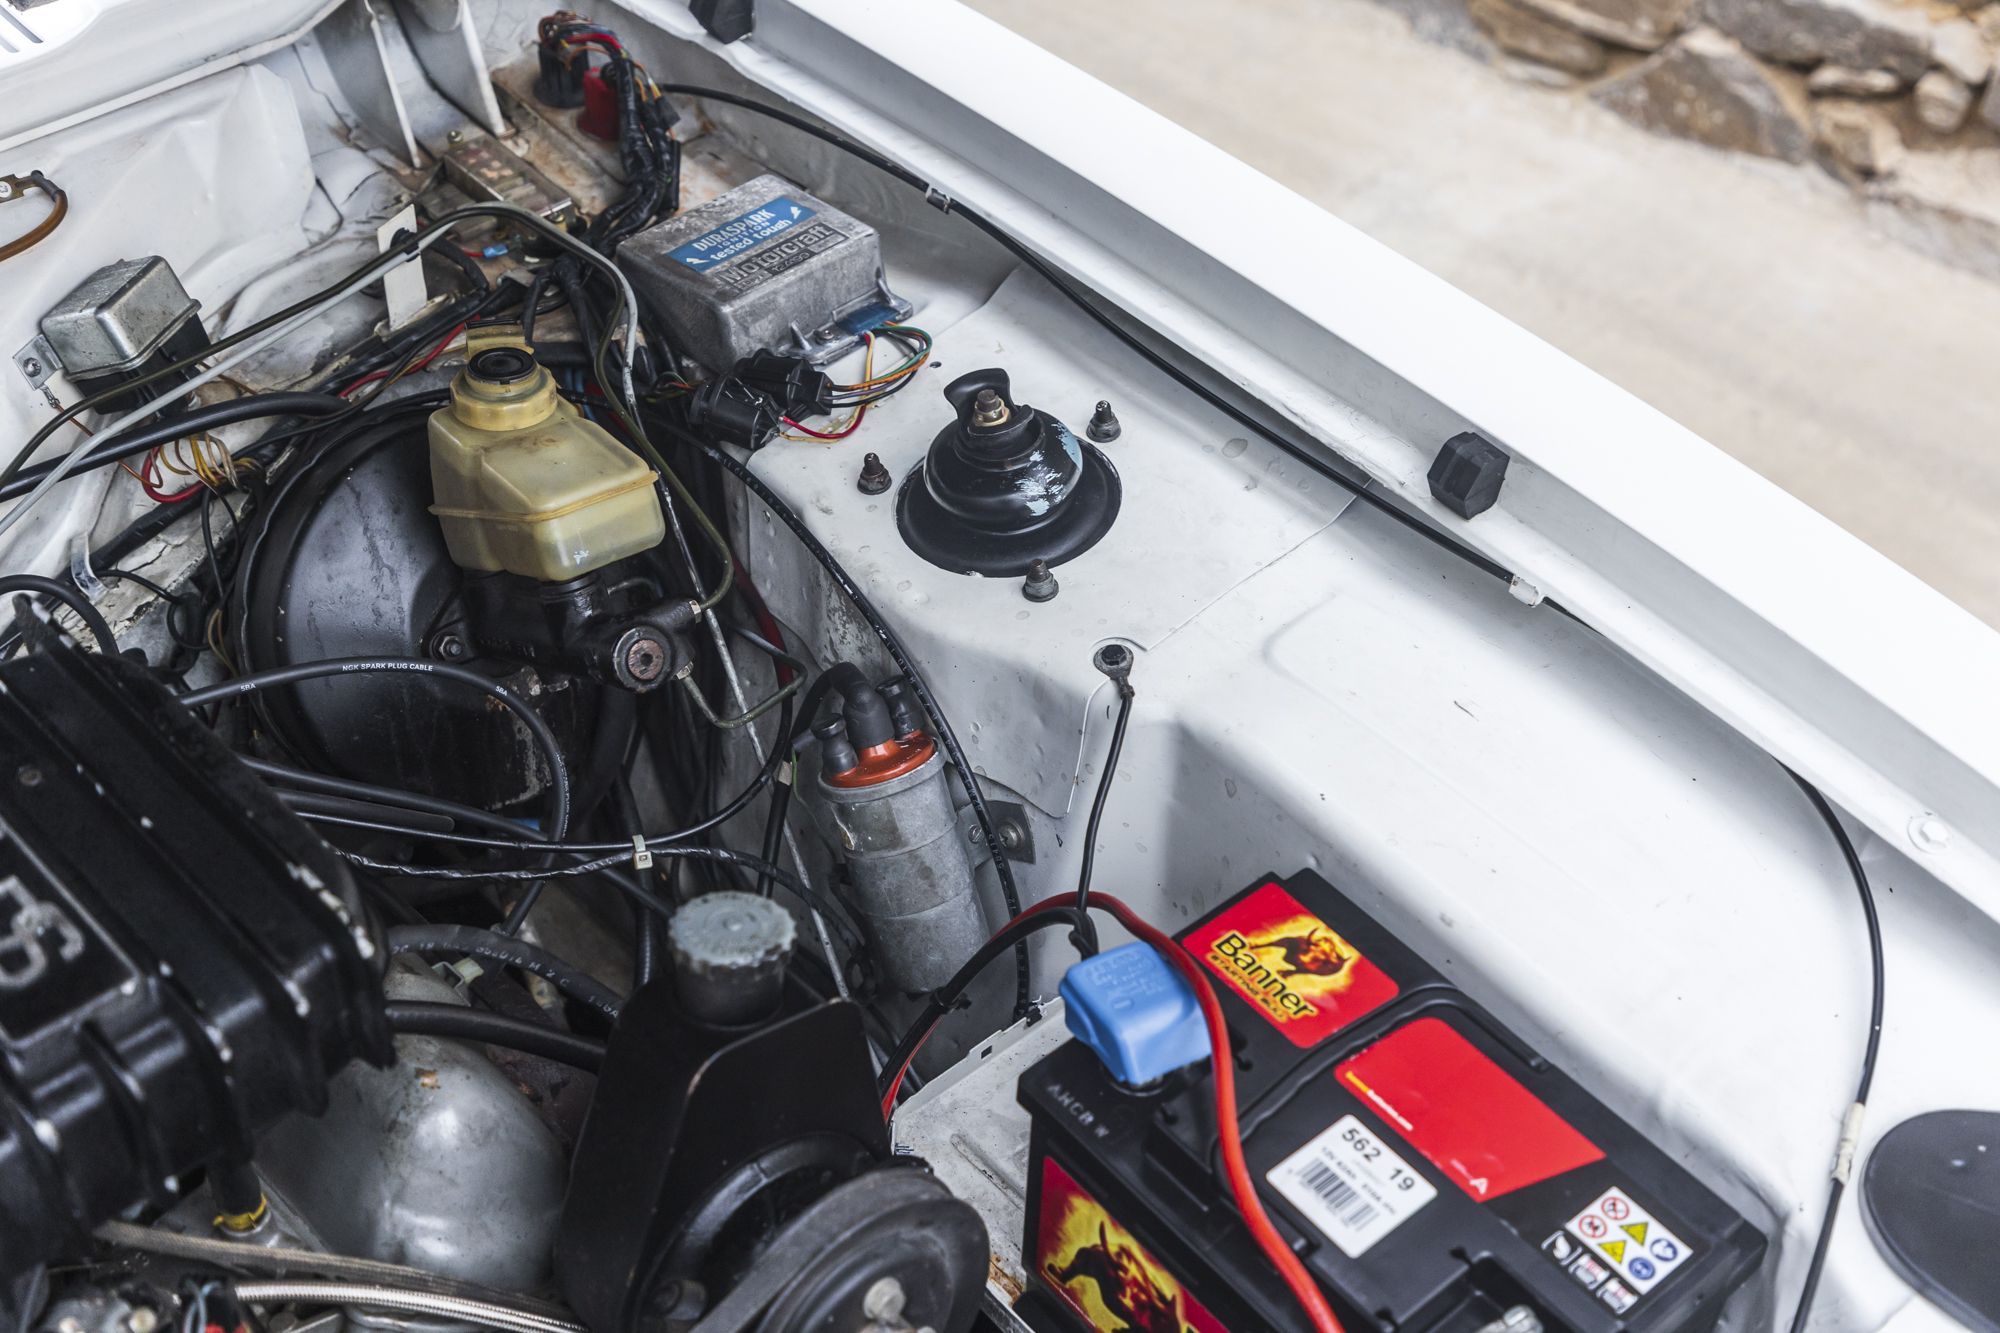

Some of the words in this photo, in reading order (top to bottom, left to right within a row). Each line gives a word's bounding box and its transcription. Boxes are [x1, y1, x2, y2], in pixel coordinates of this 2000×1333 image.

[692, 209, 777, 251] DURASPARK
[710, 238, 754, 261] tested
[753, 219, 793, 239] tough
[718, 221, 771, 249] IGNITION
[720, 225, 833, 283] Motorcraft
[342, 664, 358, 672] NGK
[360, 662, 386, 671] SPARK
[387, 662, 408, 671] PLUG
[409, 663, 433, 672] CABLE
[1215, 932, 1315, 1016] Banner
[1341, 1127, 1382, 1163] 562
[1389, 1166, 1416, 1192] 19
